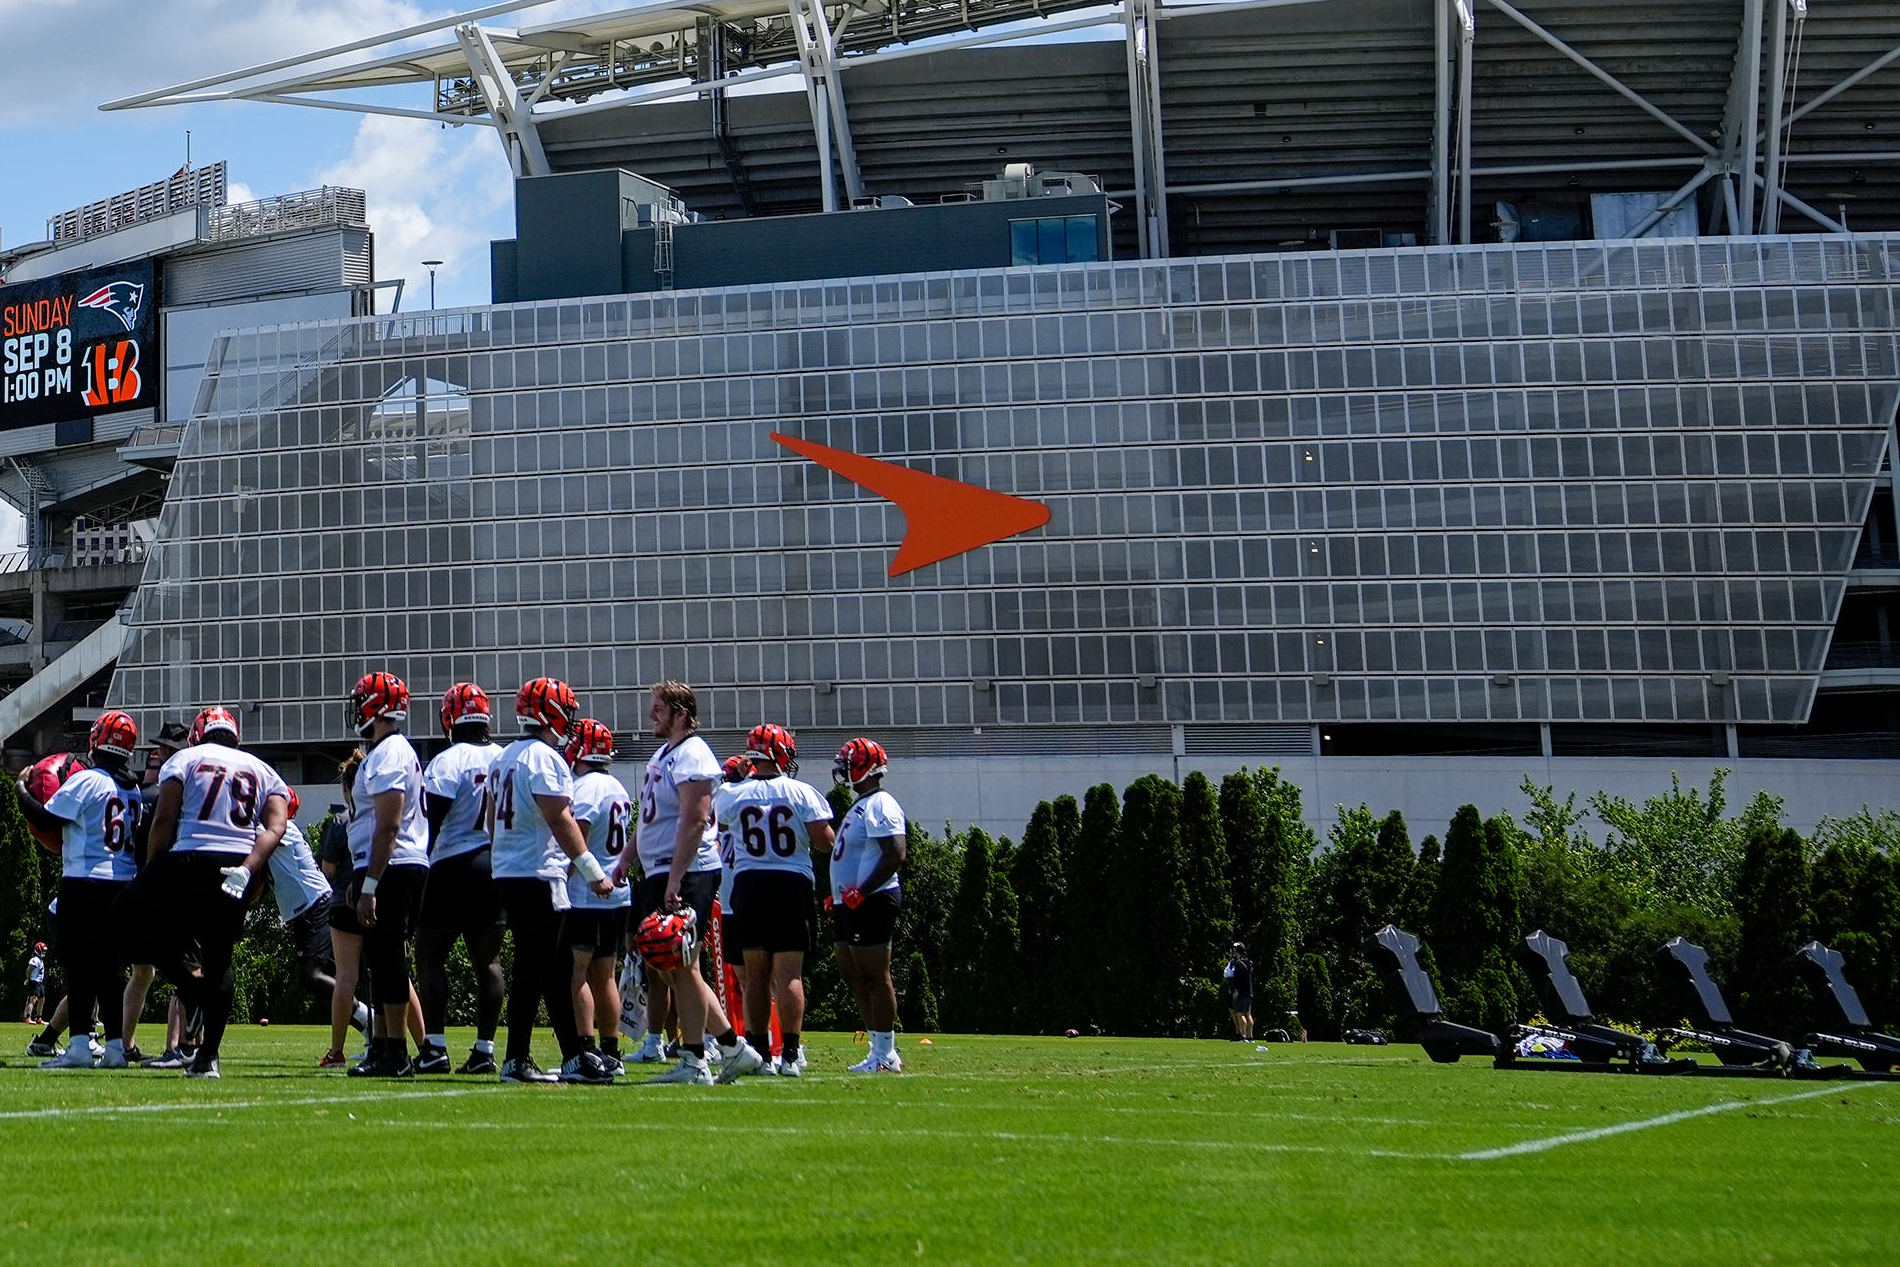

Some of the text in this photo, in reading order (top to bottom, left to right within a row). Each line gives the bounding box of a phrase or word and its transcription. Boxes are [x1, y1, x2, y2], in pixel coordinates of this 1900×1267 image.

[4, 295, 73, 337] SUNDAY
[4, 328, 72, 374] SEP 8
[4, 366, 71, 403] 1:00 PM
[197, 763, 259, 827] 79
[740, 804, 797, 858] 66
